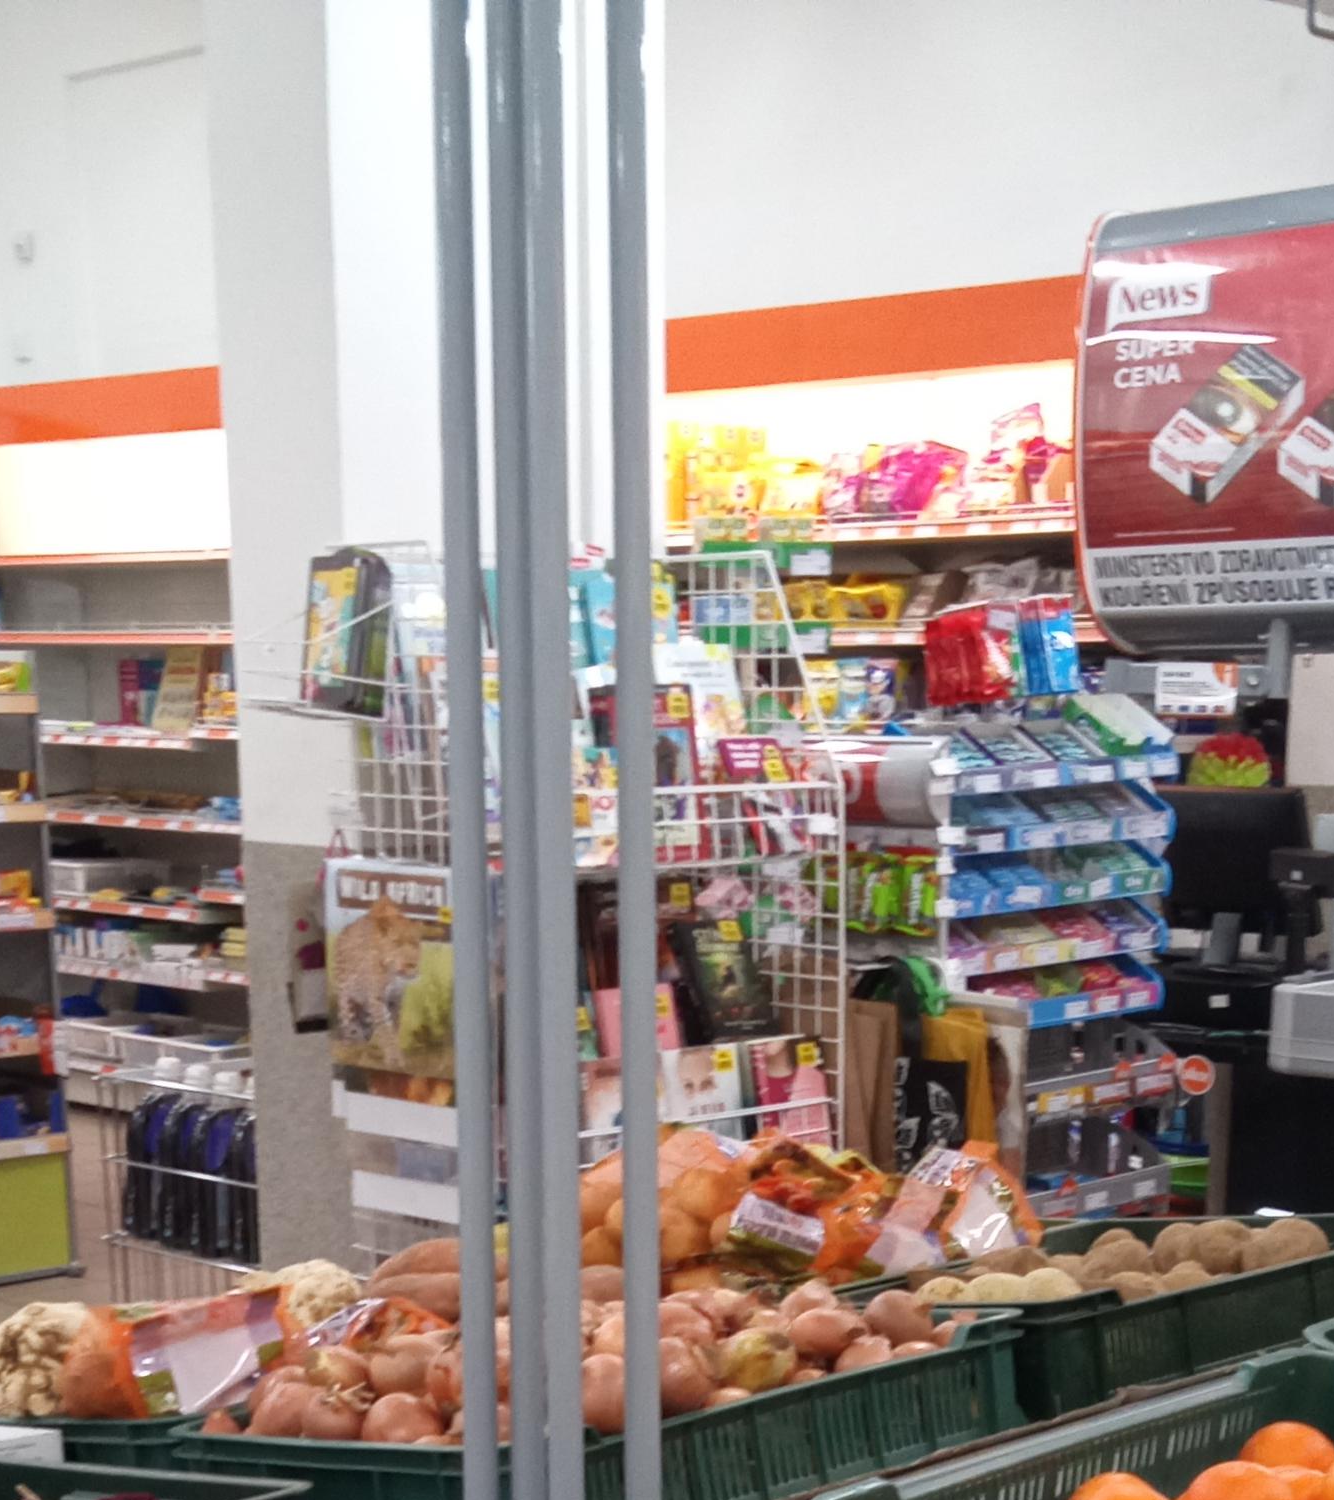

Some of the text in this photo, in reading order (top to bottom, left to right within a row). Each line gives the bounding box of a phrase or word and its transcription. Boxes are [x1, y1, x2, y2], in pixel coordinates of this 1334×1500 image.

[1118, 282, 1199, 313] News
[1114, 338, 1196, 362] SUPER
[1113, 362, 1183, 389] CENA
[1093, 550, 1216, 579] MINISTERSTVO
[1098, 578, 1191, 608] KOUŘENÍ
[1193, 575, 1320, 604] ZPŮSOBUJE
